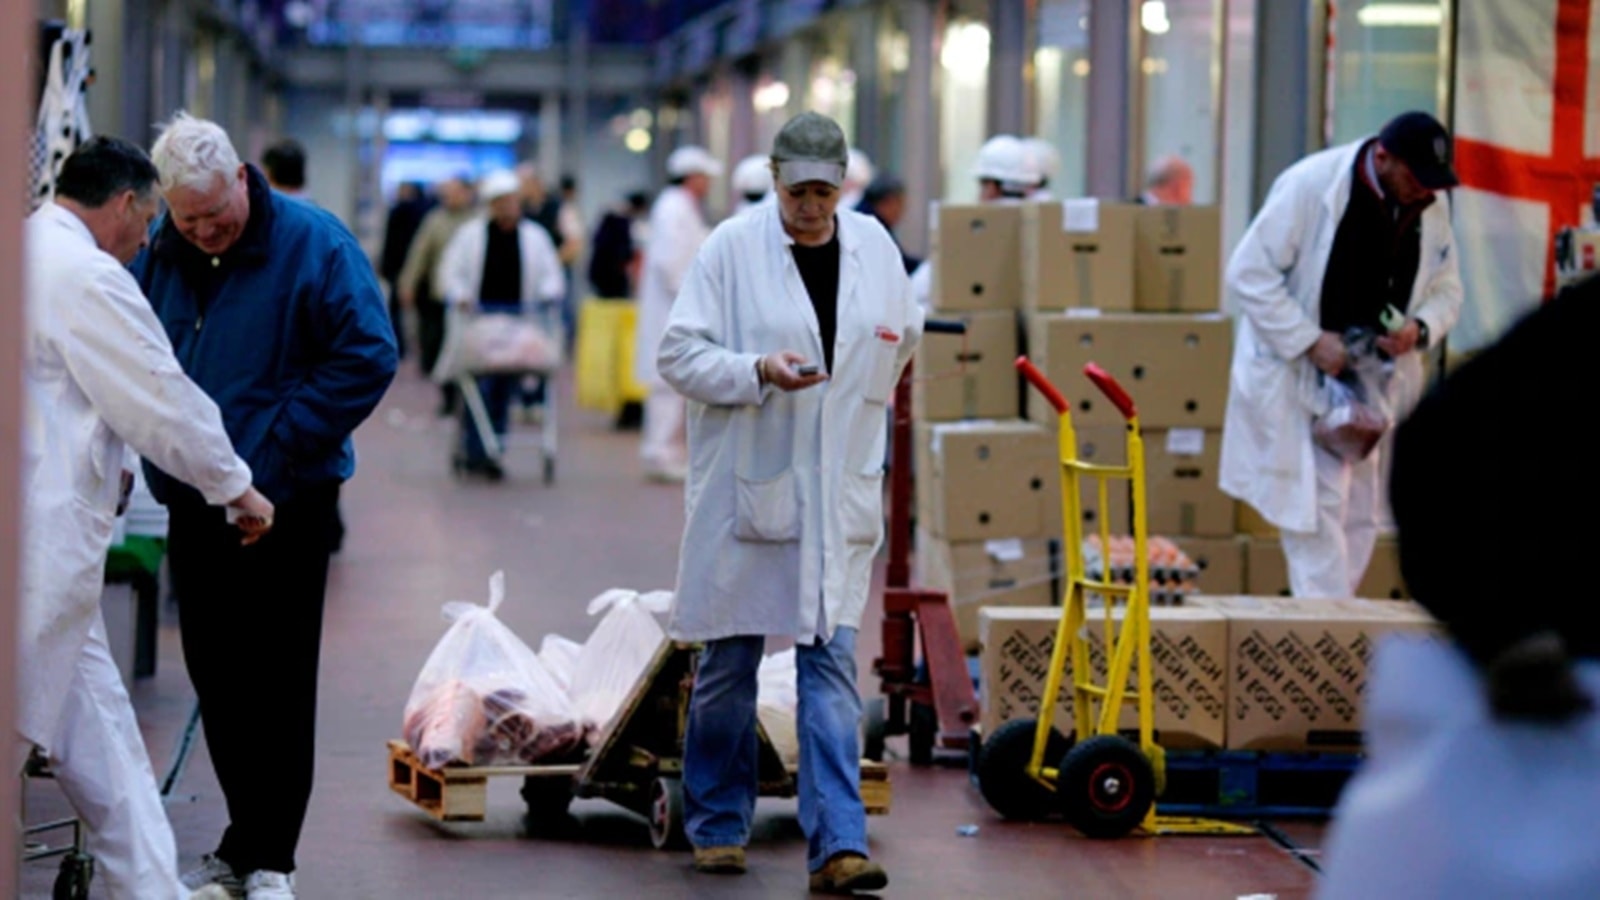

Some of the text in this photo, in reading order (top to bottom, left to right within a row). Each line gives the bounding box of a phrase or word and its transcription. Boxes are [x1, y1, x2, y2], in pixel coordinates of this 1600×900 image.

[1002, 635, 1047, 683] FRESH
[1179, 635, 1223, 682] FRESH
[1240, 635, 1285, 683] FRESH
[1281, 679, 1322, 722] EGGS
[1275, 636, 1320, 684] FRESH
[1317, 679, 1358, 723] EGGS
[1313, 637, 1359, 684] FRESH
[1152, 679, 1190, 721] EGGS
[1186, 678, 1222, 720] EGGS
[1245, 679, 1287, 721] EGGS
